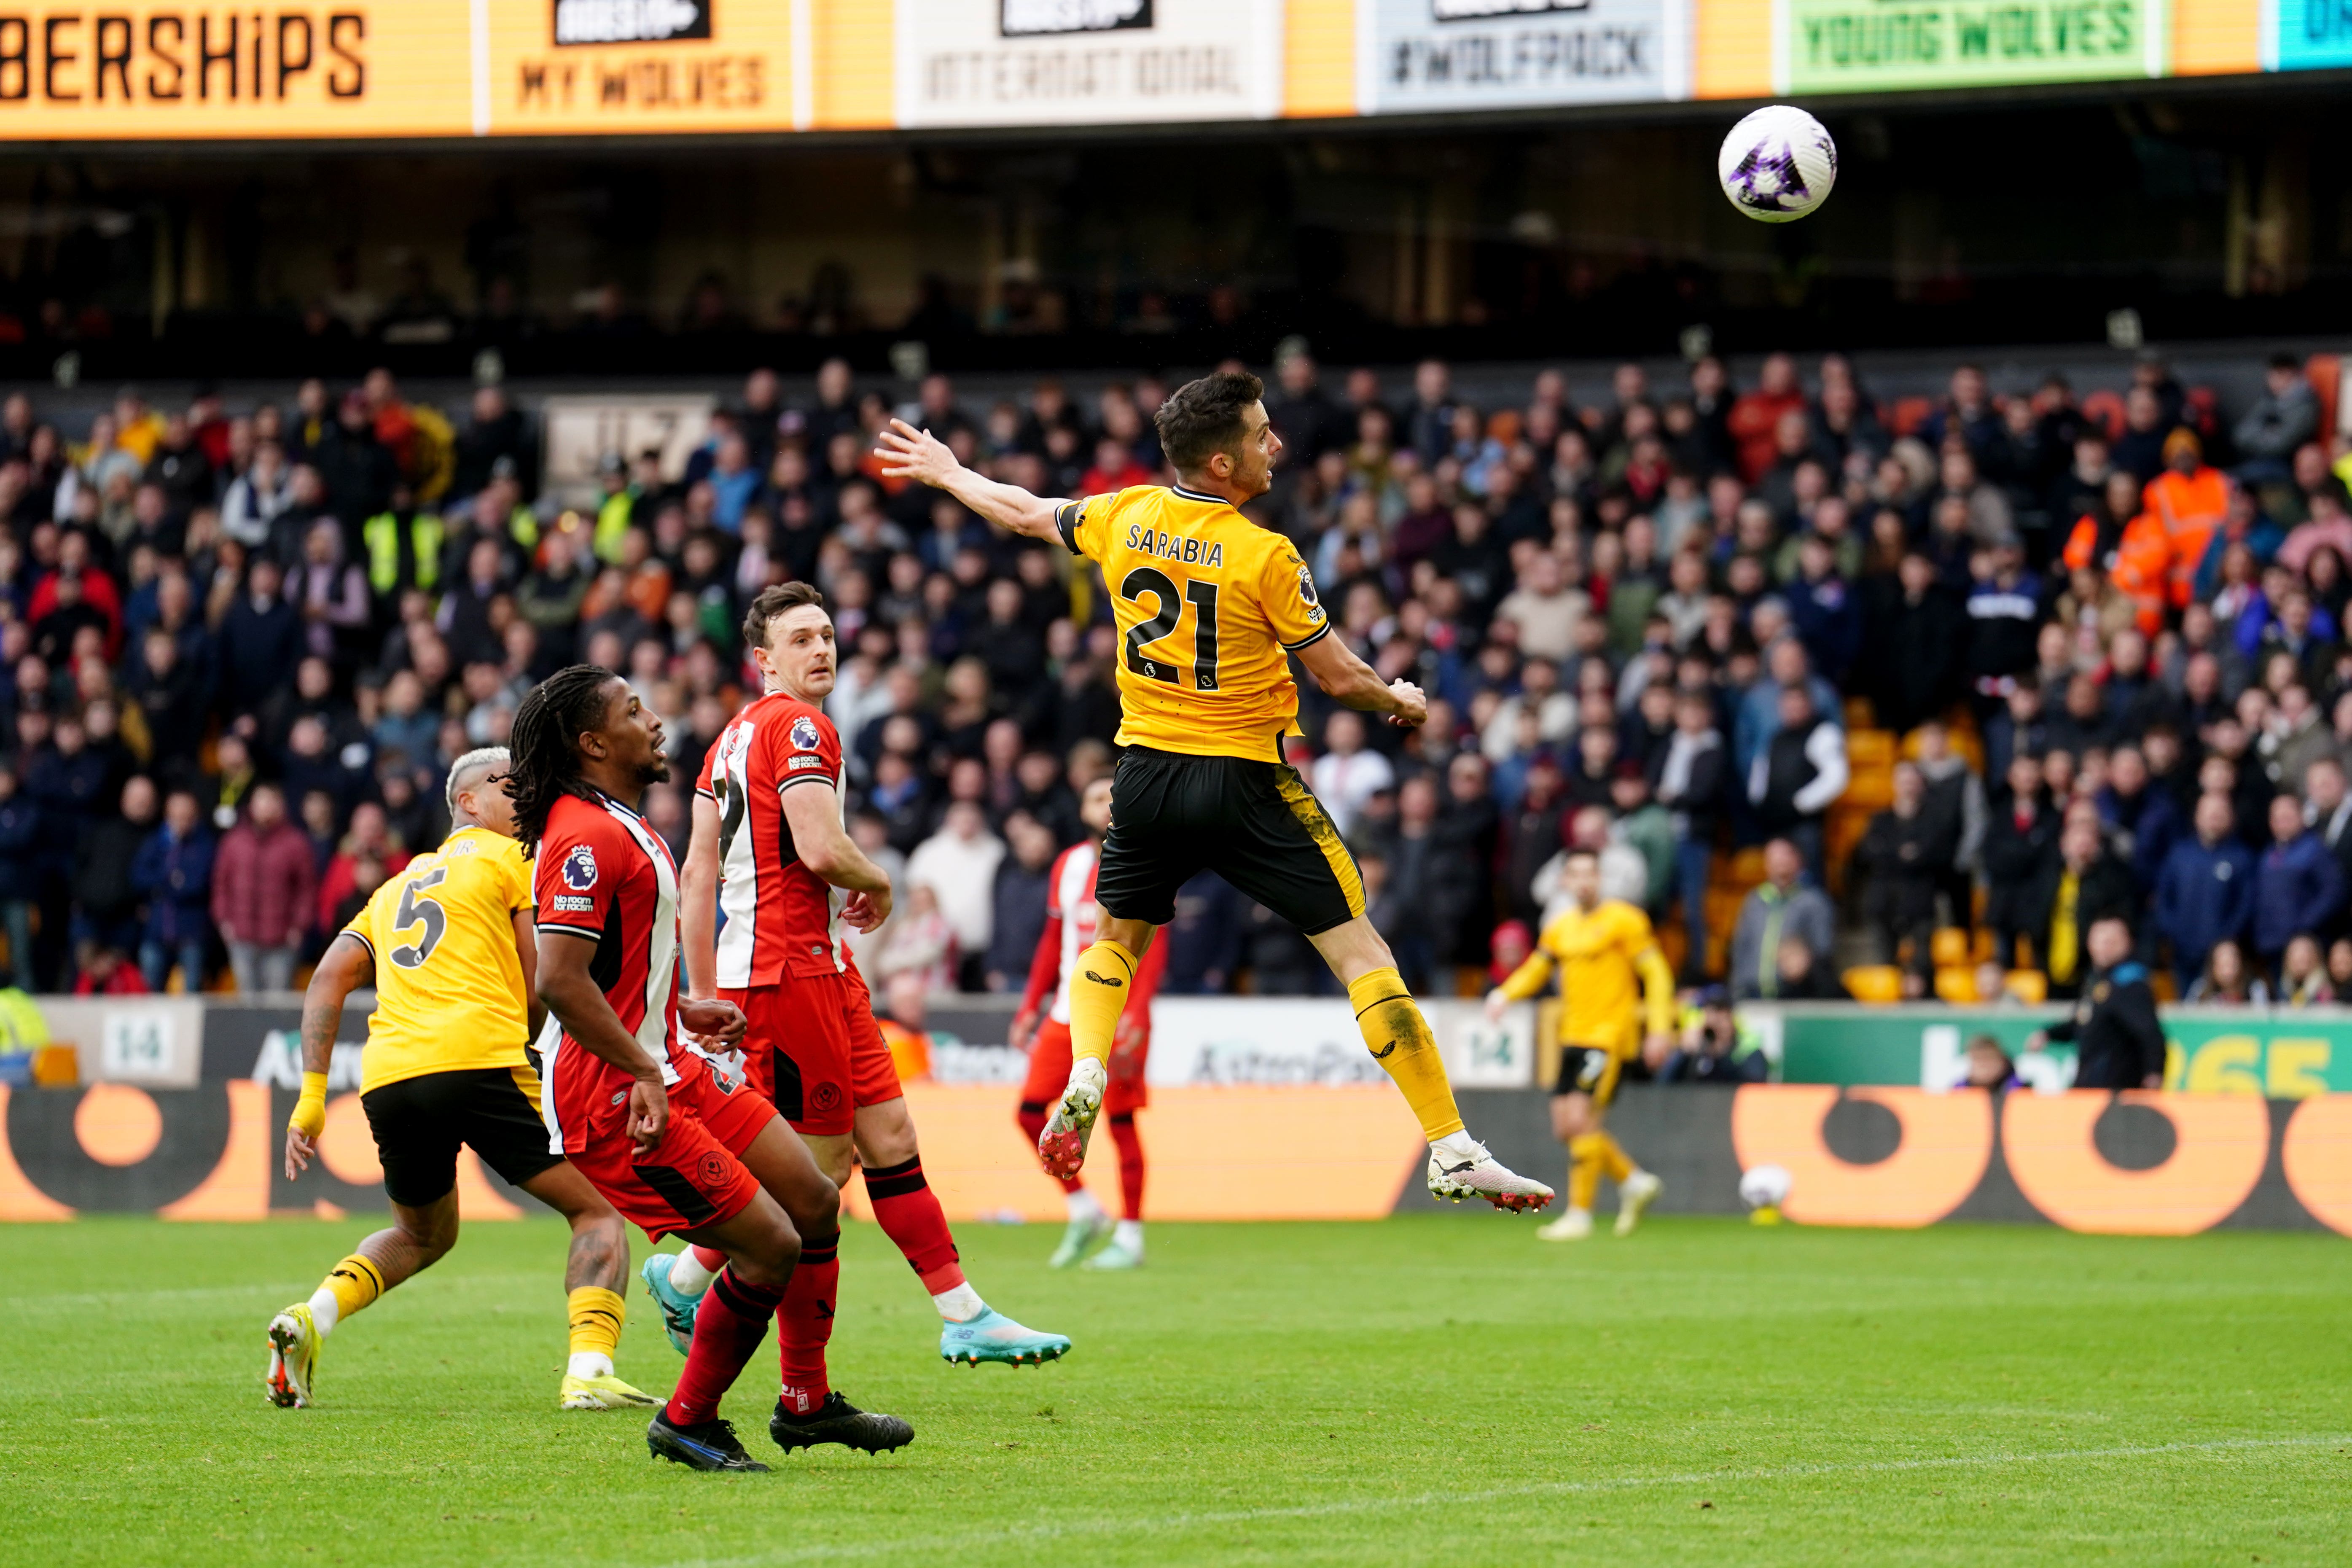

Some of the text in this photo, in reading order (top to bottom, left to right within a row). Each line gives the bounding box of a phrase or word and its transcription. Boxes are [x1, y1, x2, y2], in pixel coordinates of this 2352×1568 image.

[519, 55, 767, 111] MY WOLVES
[1125, 524, 1223, 568] SARABIA
[1121, 566, 1220, 691] 21
[789, 763, 800, 771] for
[389, 866, 448, 969] 5
[554, 895, 591, 904] No room
[554, 903, 593, 912] for racism
[116, 1020, 164, 1063] 14
[1470, 1027, 1514, 1068] 14
